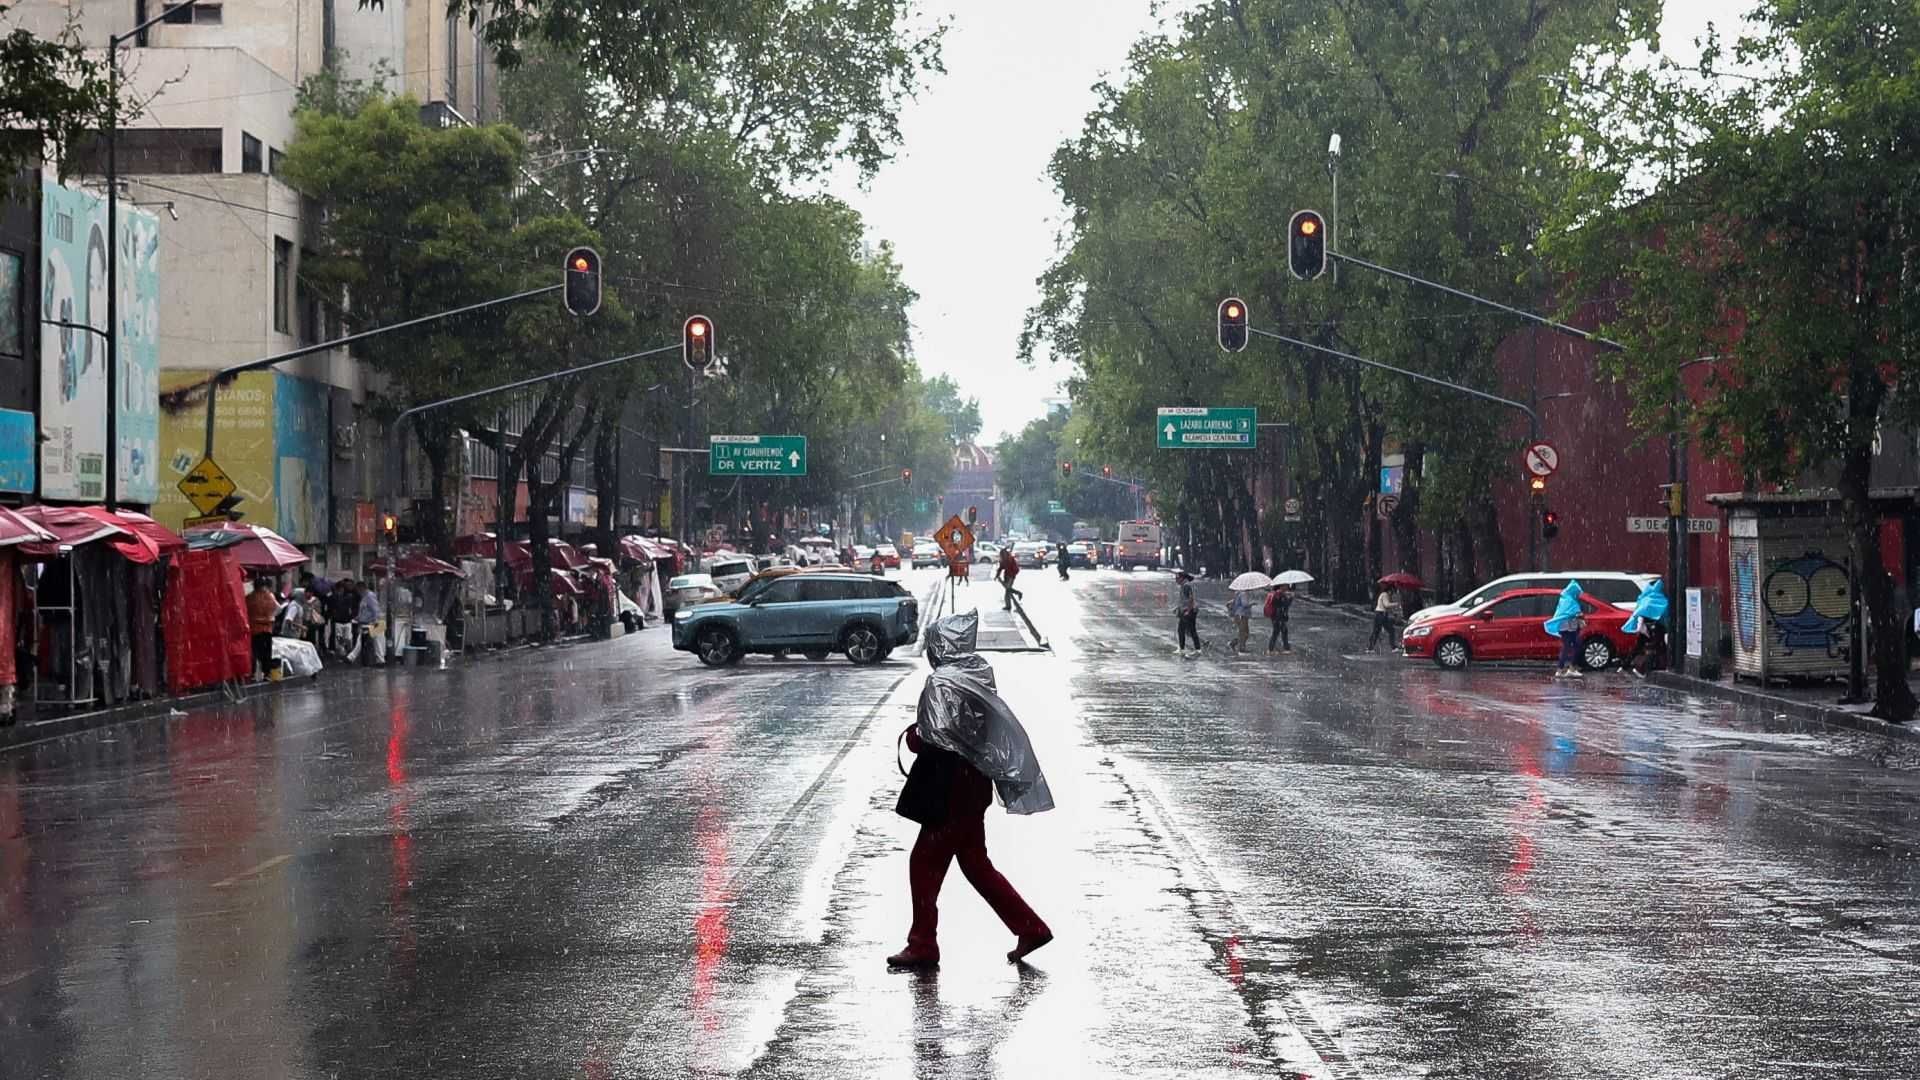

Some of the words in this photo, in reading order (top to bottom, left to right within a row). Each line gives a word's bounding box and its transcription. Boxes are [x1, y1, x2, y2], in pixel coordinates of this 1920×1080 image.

[718, 460, 735, 470] DR
[740, 460, 782, 470] VERTIZ
[1634, 519, 1641, 530] 5
[1646, 519, 1660, 530] DE
